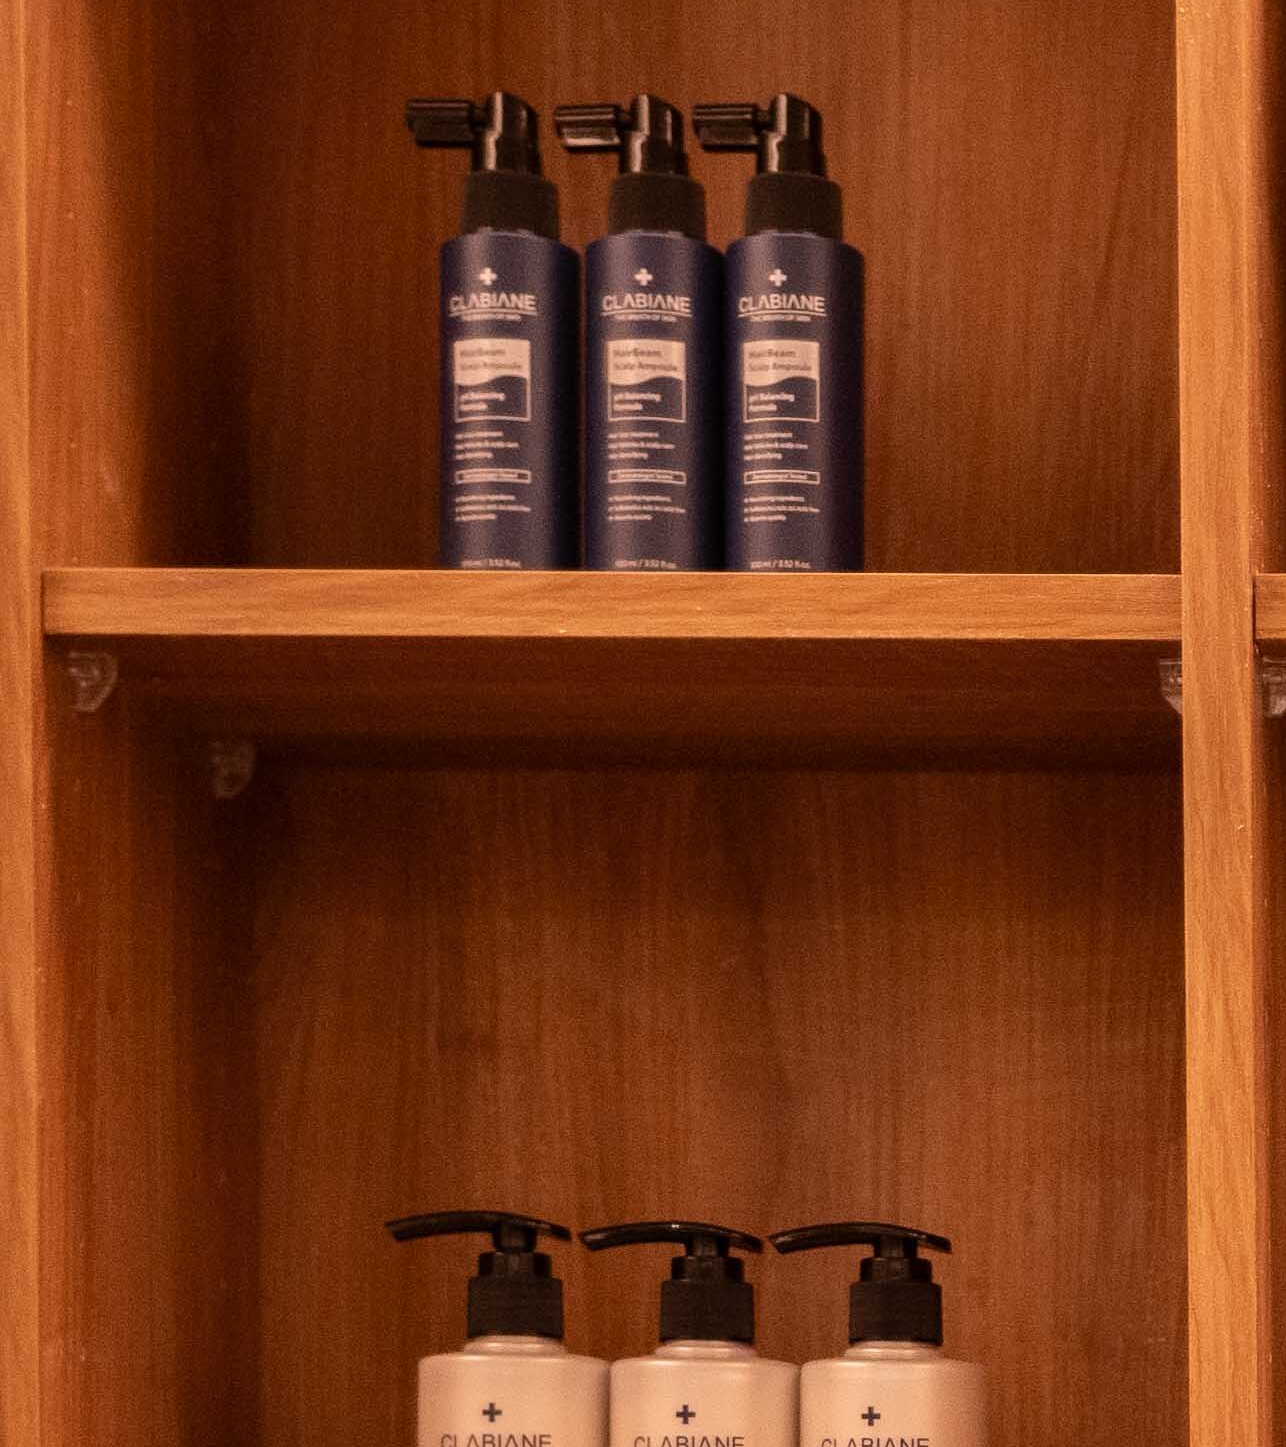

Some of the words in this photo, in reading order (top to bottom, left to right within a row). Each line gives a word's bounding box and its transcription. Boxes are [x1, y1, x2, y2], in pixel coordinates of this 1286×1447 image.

[450, 293, 536, 311] CLABIANE
[602, 294, 691, 312] CLABIANE
[738, 294, 825, 312] CLABIANE
